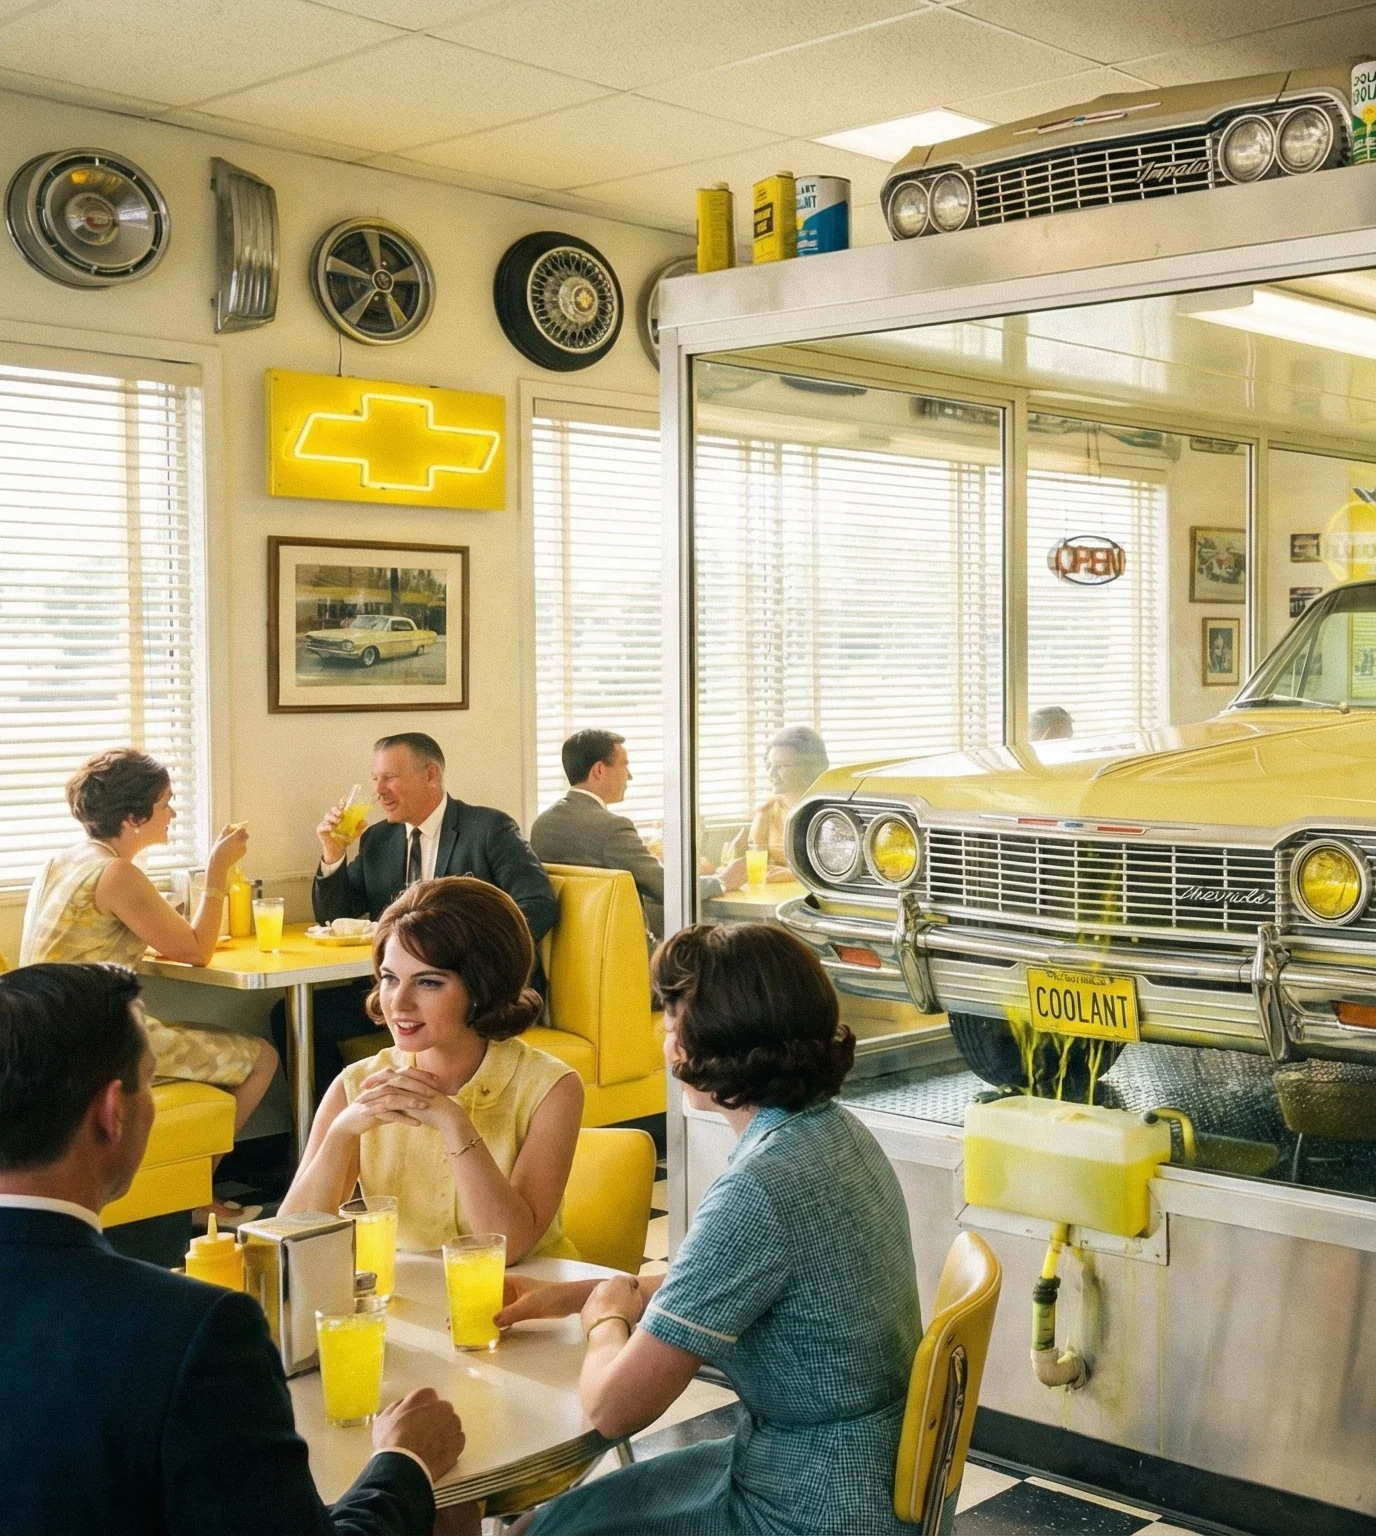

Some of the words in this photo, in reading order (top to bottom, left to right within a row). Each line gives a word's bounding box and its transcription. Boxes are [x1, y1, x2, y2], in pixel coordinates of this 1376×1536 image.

[1135, 158, 1209, 183] Impala
[1055, 545, 1126, 576] OPEN
[1036, 986, 1128, 1029] COOLANT
